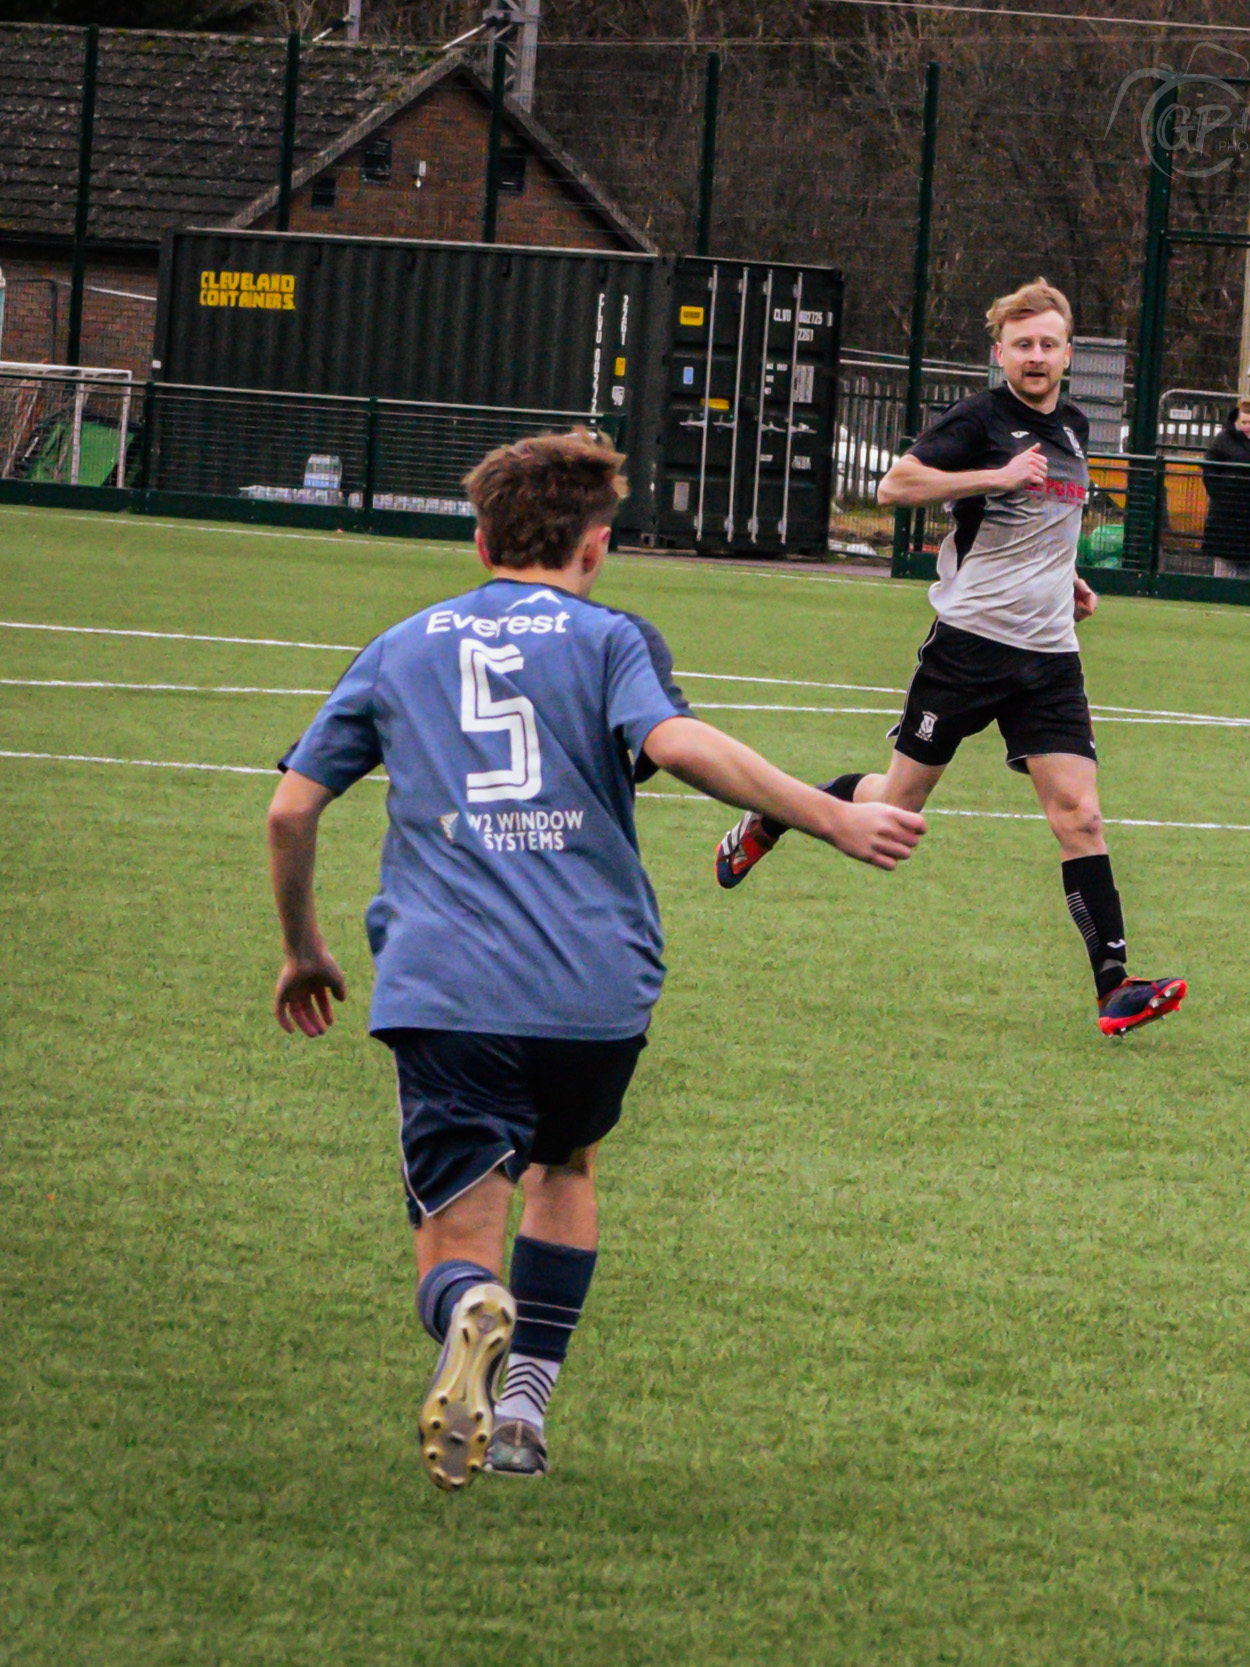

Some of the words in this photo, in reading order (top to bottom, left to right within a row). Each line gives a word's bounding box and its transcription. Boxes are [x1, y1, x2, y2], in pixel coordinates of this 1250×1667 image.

[201, 271, 296, 293] CLEVELAND
[200, 289, 296, 310] CONTAINERS
[426, 609, 571, 638] Everest
[459, 638, 542, 803] 5
[496, 810, 584, 832] WINDOW
[483, 830, 565, 852] SYSTEMS
